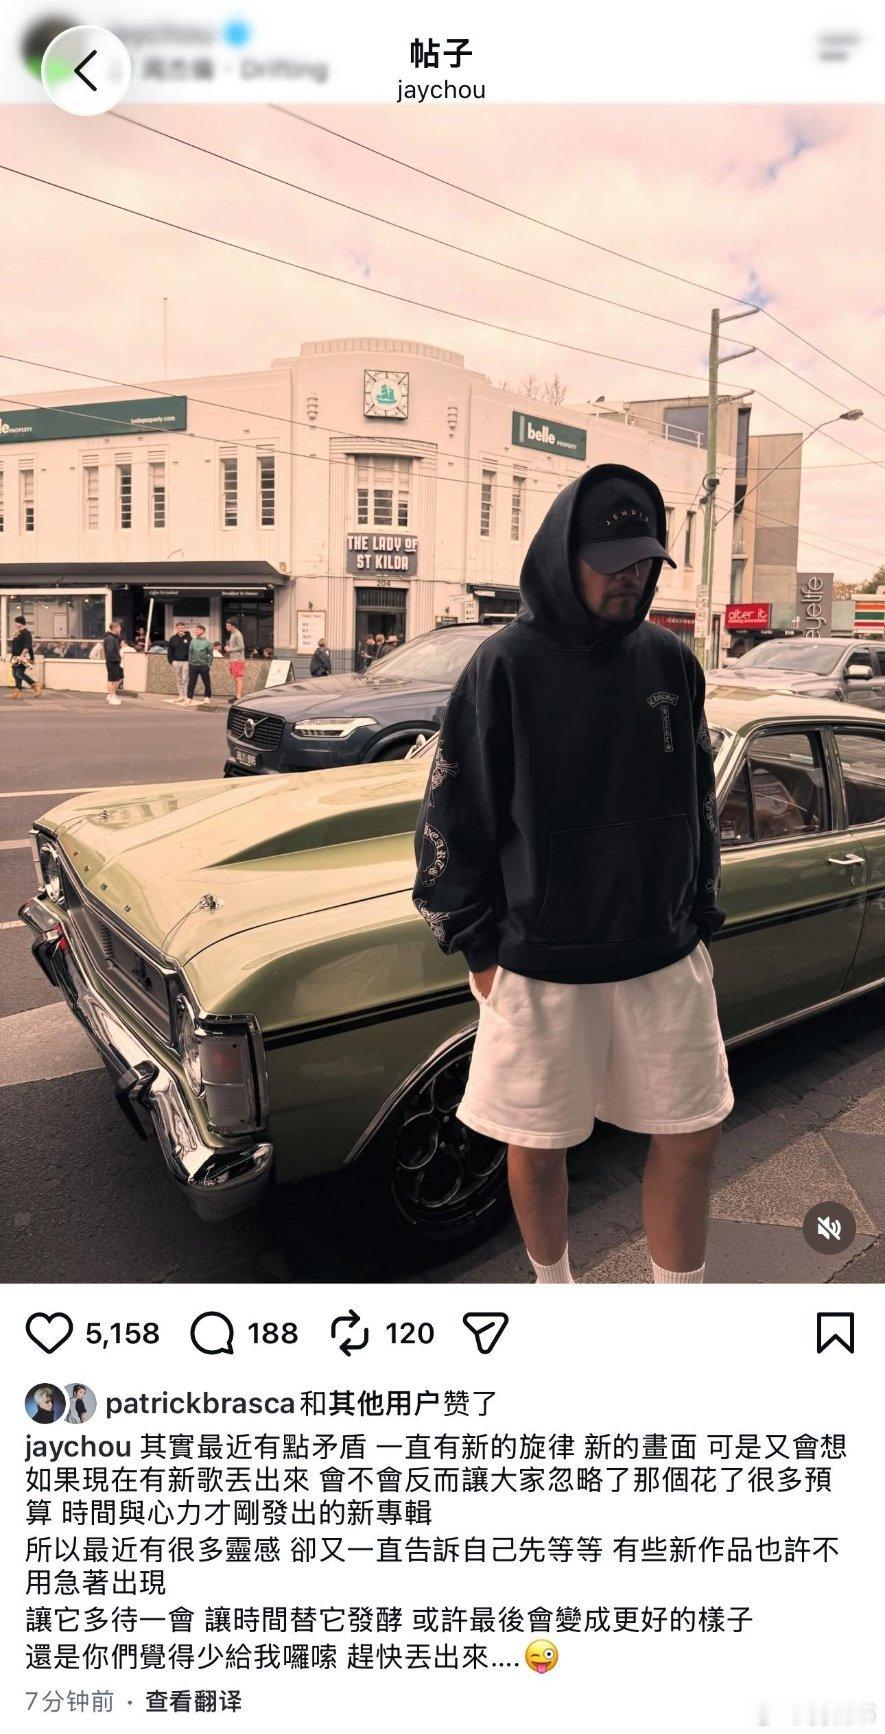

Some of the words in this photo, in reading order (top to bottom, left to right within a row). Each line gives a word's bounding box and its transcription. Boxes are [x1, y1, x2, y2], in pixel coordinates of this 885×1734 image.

[527, 421, 556, 445] belle
[347, 535, 369, 551] THE
[372, 536, 402, 552] LADY
[404, 537, 418, 551] OF
[356, 554, 372, 569] ST
[375, 554, 409, 571] KILDA
[728, 609, 755, 619] alter
[757, 608, 767, 619] it
[801, 576, 827, 638] eyelife
